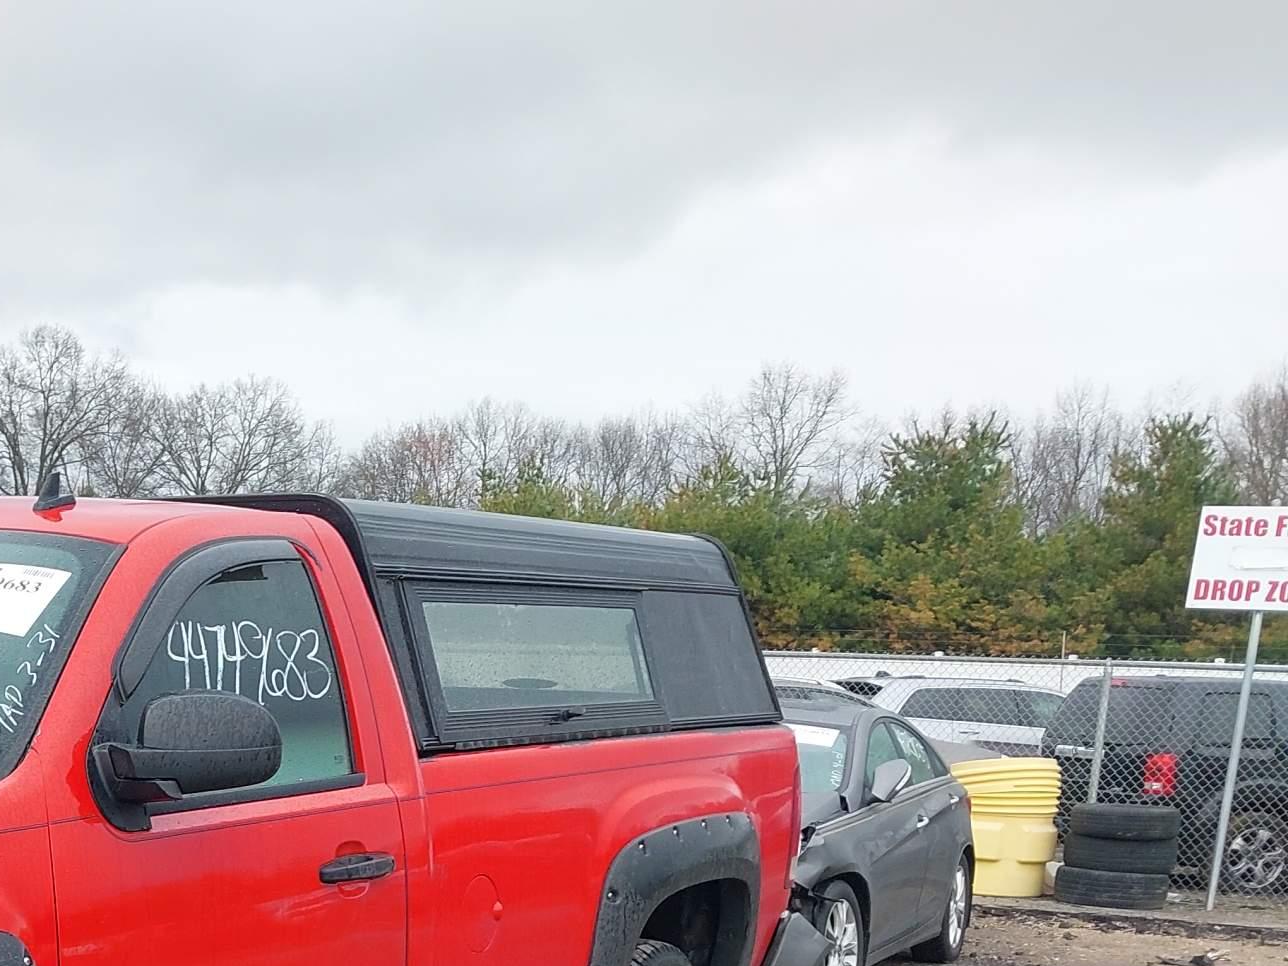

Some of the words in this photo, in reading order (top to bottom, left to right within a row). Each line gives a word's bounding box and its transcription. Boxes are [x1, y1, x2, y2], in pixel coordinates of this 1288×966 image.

[1203, 514, 1269, 537] State
[1275, 515, 1288, 537] F
[1193, 578, 1261, 602] DROP
[16, 623, 61, 687] 3-31
[167, 620, 332, 706] 44749683
